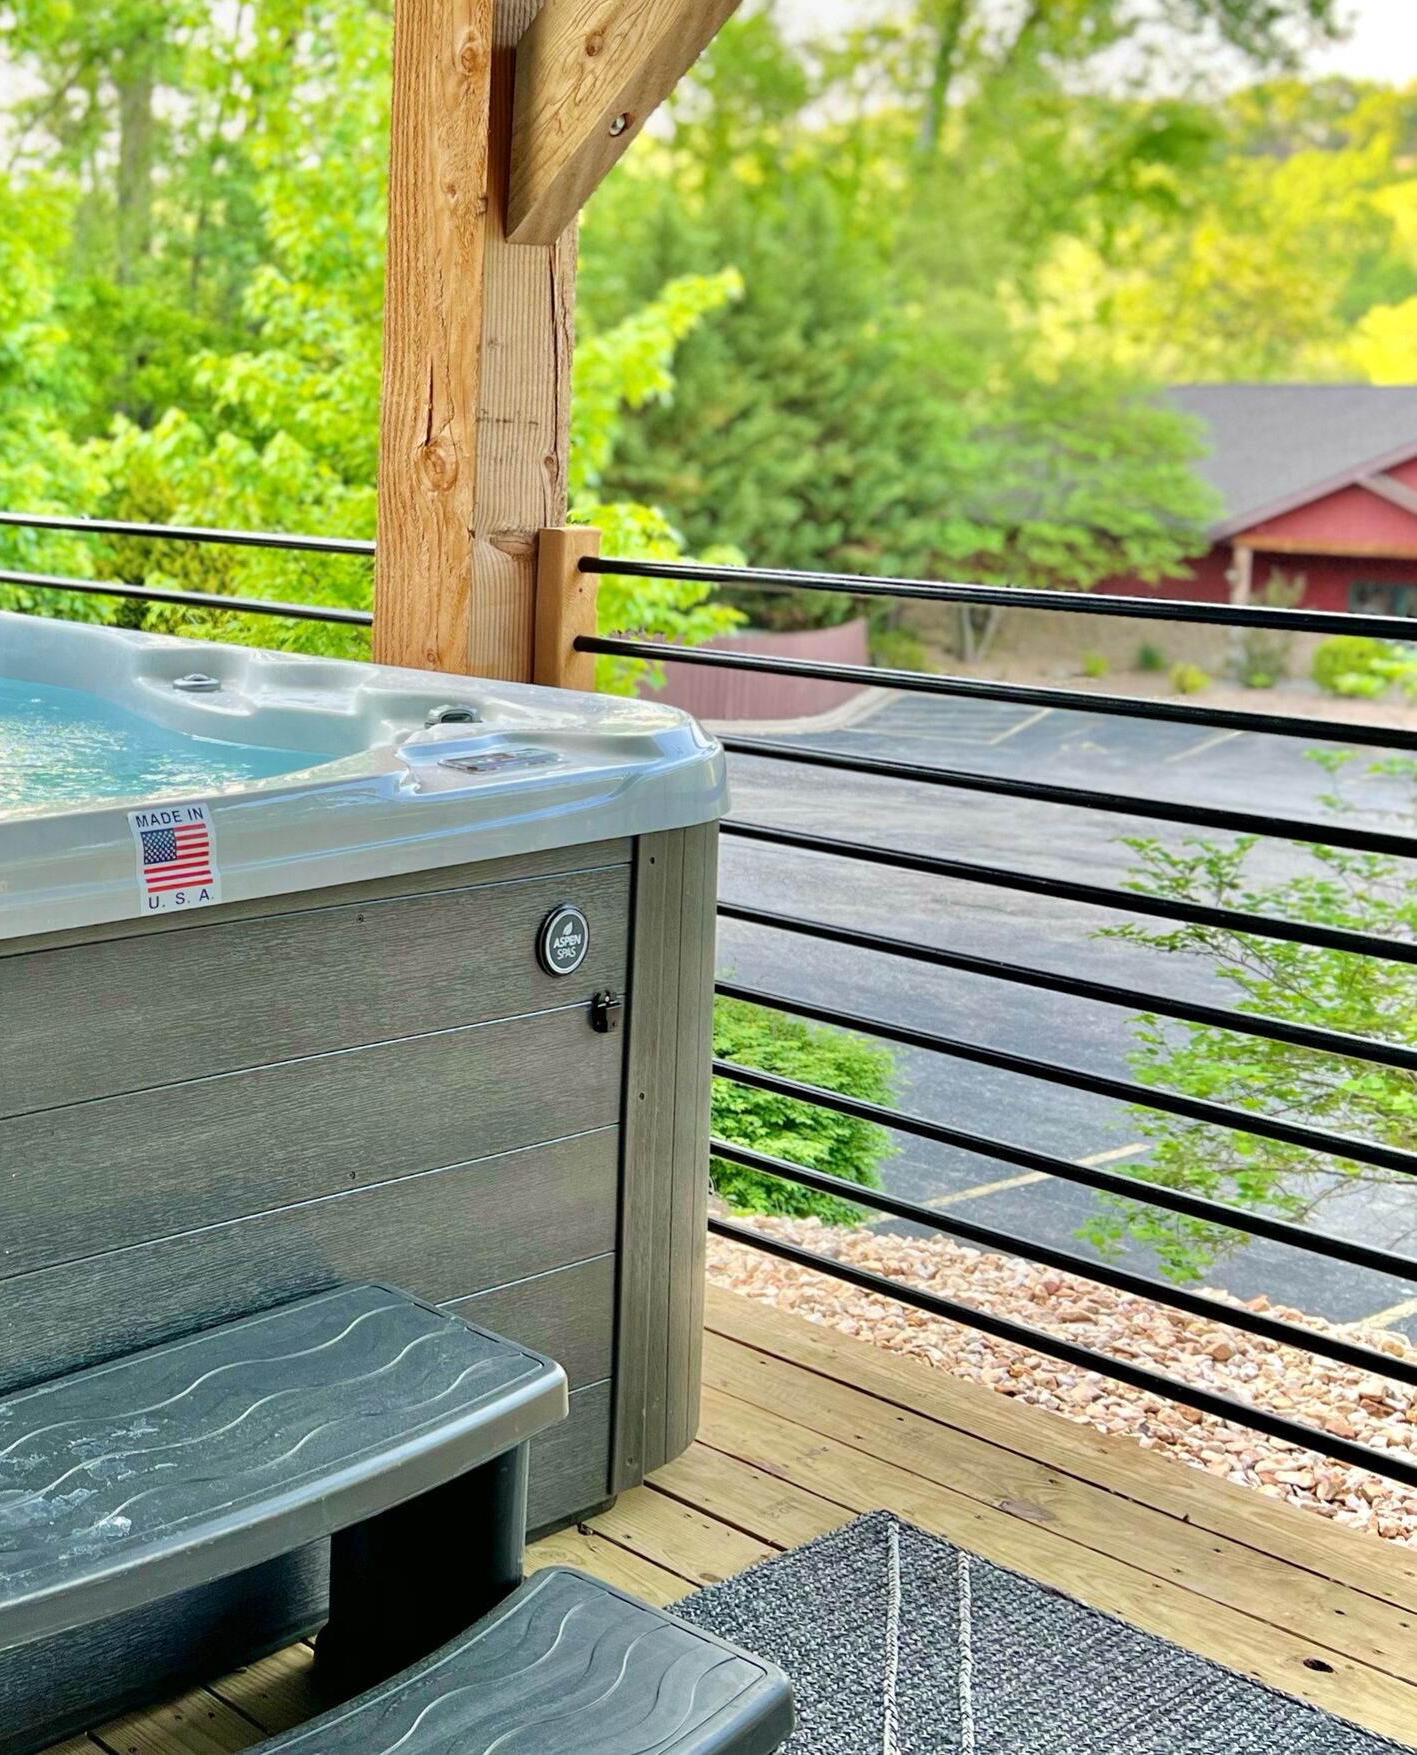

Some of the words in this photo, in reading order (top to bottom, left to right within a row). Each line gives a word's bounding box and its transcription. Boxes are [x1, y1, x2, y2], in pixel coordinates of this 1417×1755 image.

[135, 810, 183, 828] MADE
[187, 807, 204, 821] IN
[553, 934, 582, 949] ASPEN
[557, 946, 576, 960] SPAS
